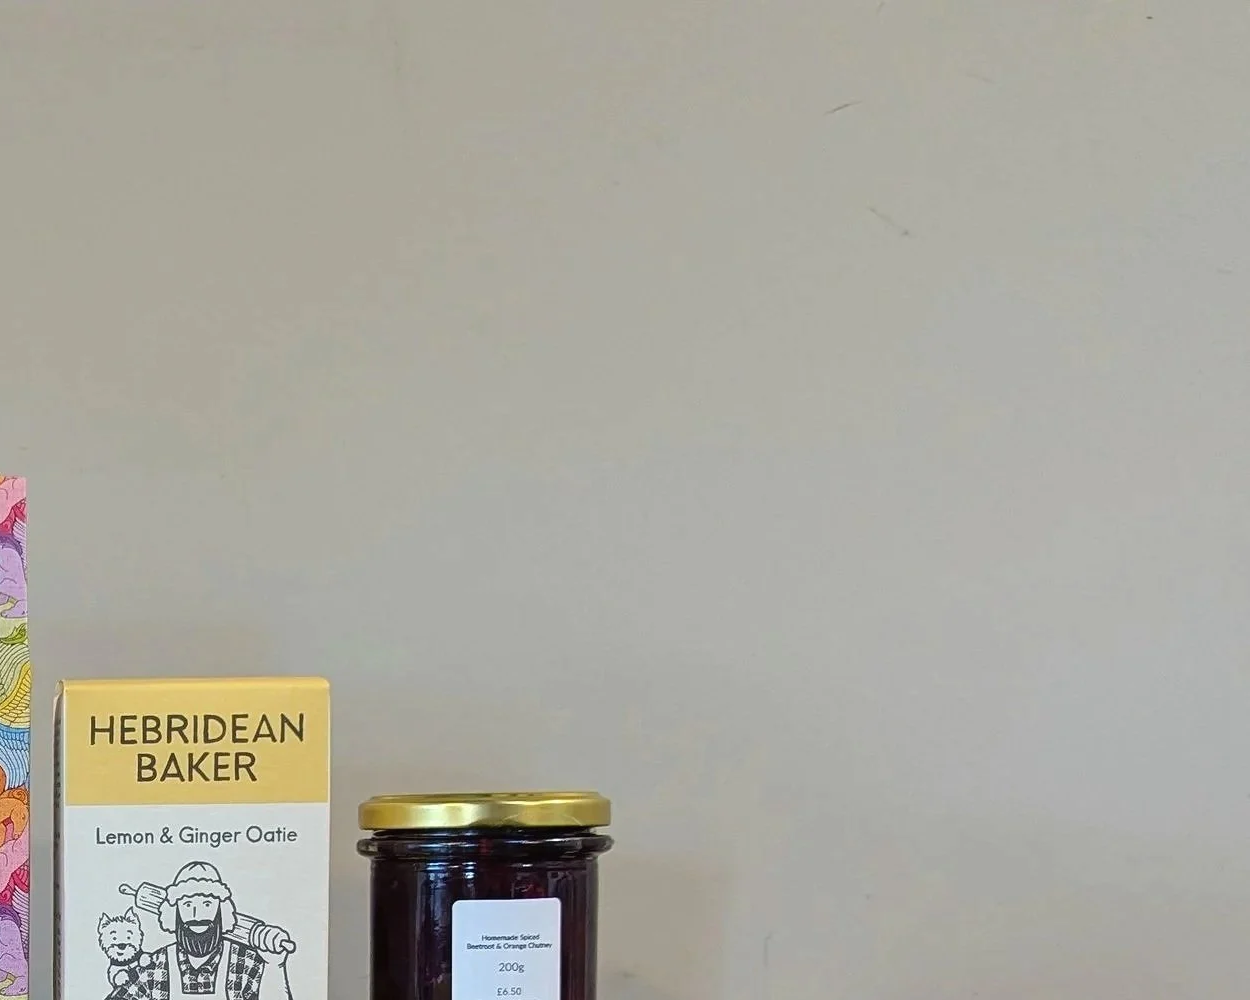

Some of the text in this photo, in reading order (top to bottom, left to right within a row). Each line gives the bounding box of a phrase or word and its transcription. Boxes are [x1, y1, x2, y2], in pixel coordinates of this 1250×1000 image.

[90, 713, 305, 745] HEBRIDEAN
[136, 751, 258, 783] BAKER
[96, 825, 298, 848] Lemon & Ginger Oatie
[481, 933, 540, 942] Homemade Spiced
[499, 962, 525, 974] 200g
[497, 987, 522, 996] £6.50
